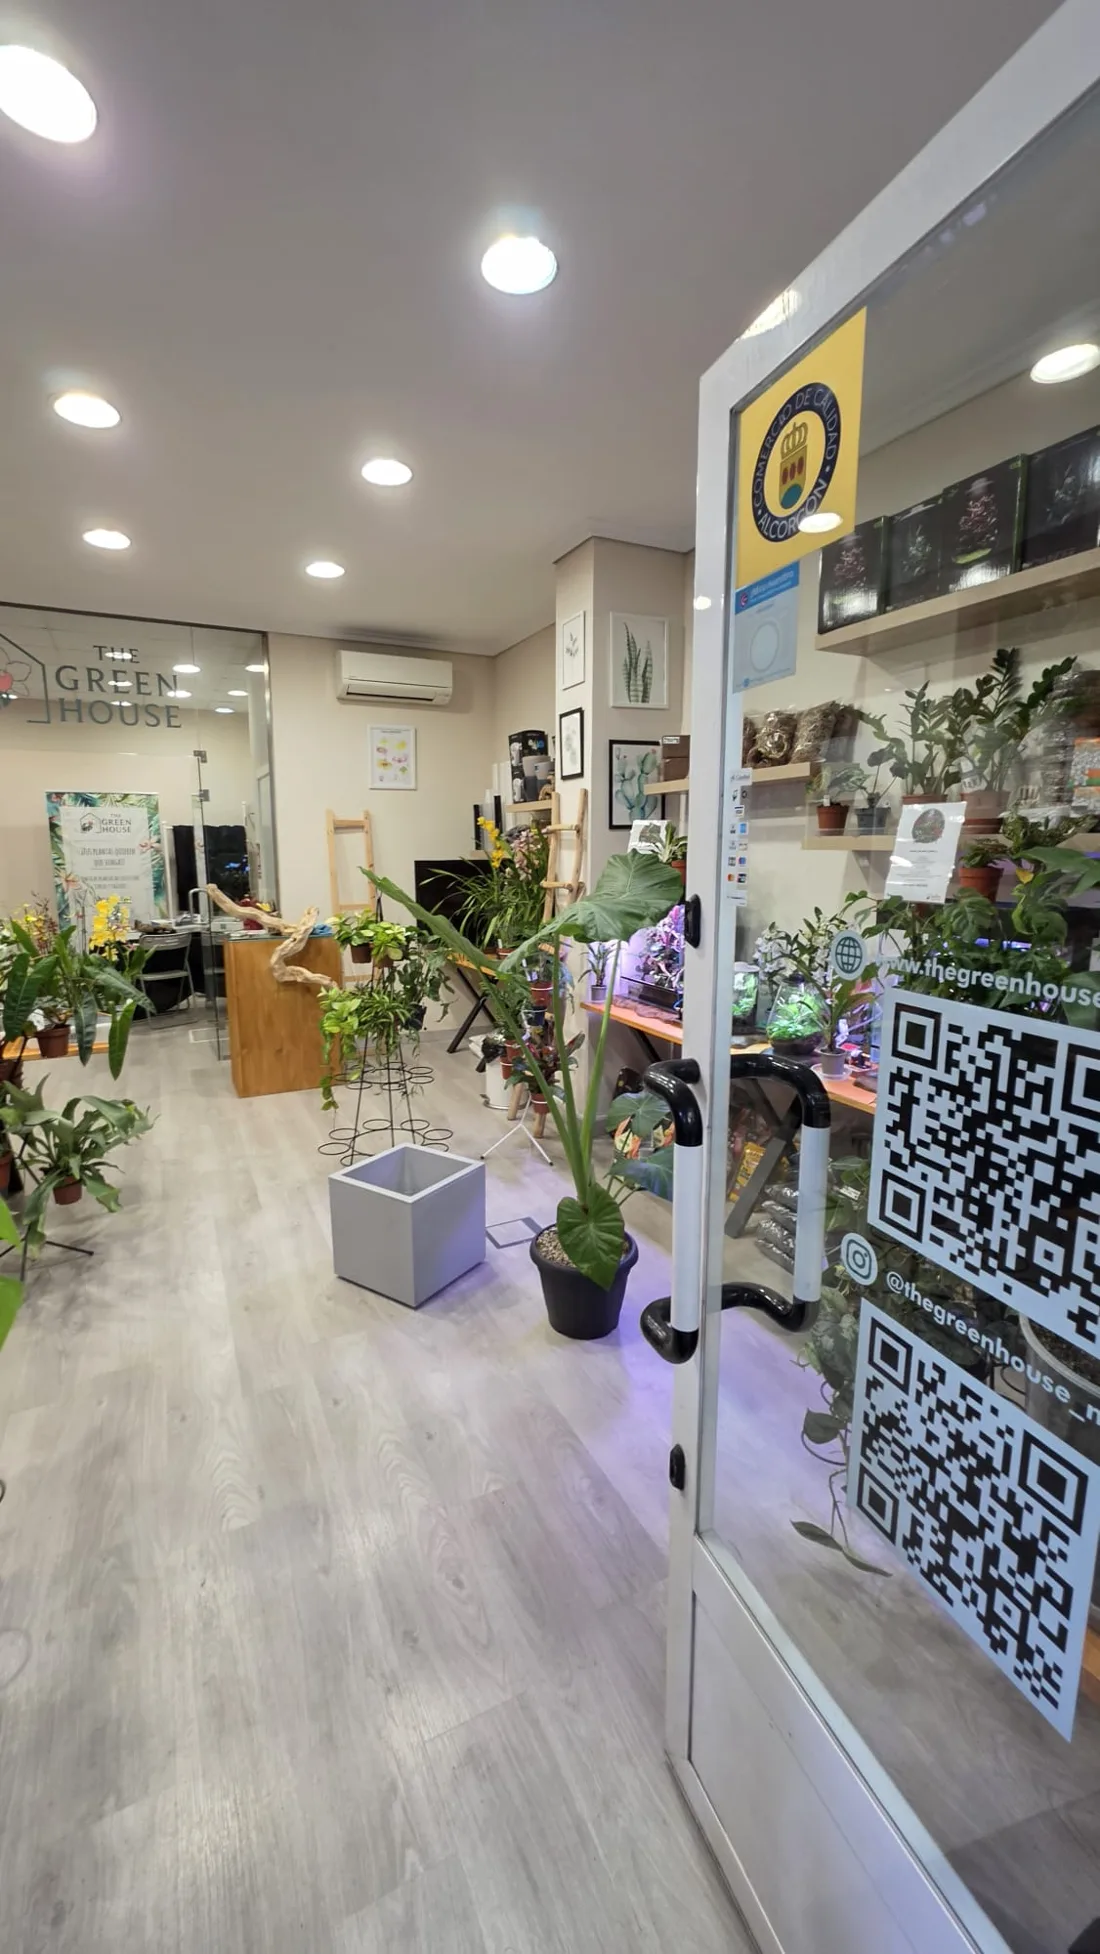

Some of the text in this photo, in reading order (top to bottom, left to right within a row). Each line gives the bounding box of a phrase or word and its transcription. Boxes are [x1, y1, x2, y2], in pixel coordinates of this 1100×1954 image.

[753, 387, 839, 508] COMERCIO DE CALIDAD
[92, 644, 141, 664] THE
[54, 664, 179, 698] GREEN
[57, 697, 183, 729] HOUSE
[101, 818, 133, 827] GREEN
[102, 825, 132, 834] HOUSE
